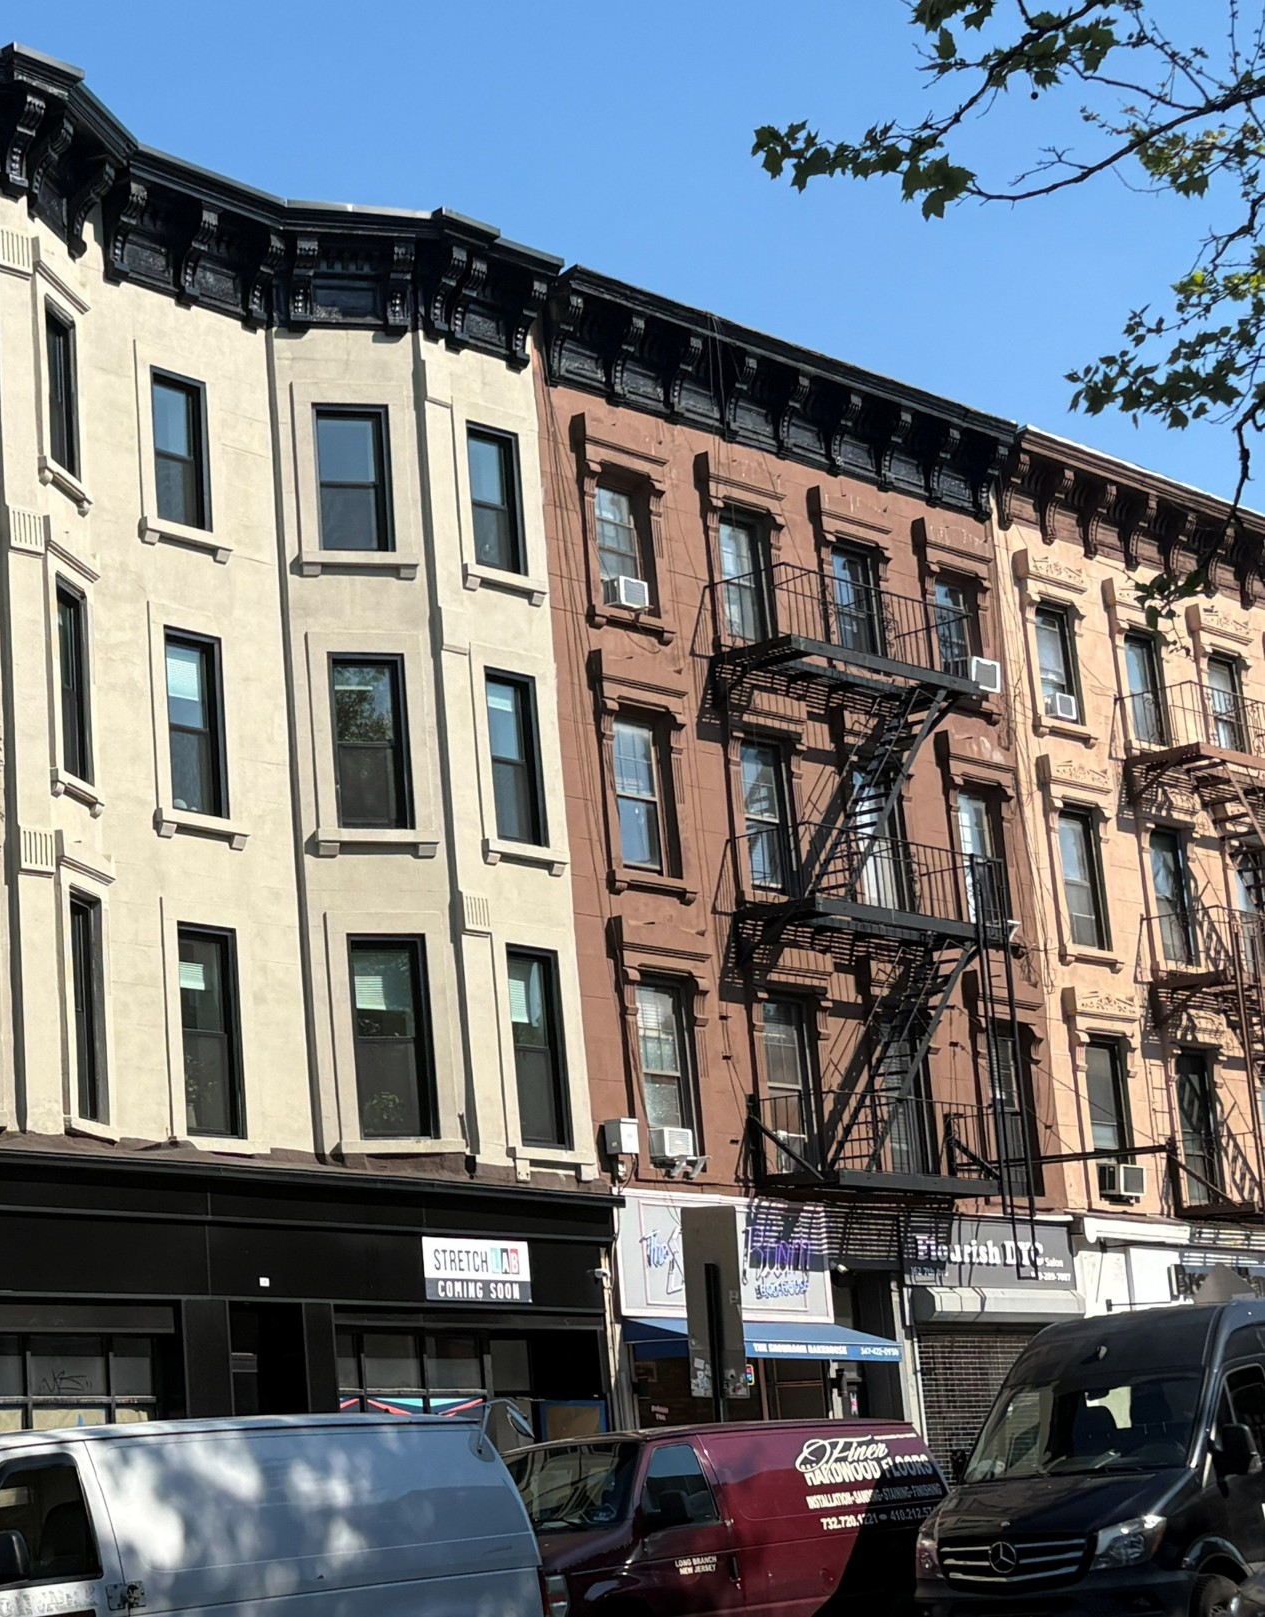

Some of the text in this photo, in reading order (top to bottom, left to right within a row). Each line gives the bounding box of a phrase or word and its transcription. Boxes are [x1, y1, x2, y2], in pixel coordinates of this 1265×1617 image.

[437, 1280, 520, 1300] COMING SOON
[804, 1454, 933, 1486] HARDWOOD FLOORS
[675, 1556, 717, 1567] LONG BRANCH
[679, 1564, 716, 1575] NEW JERSEY
